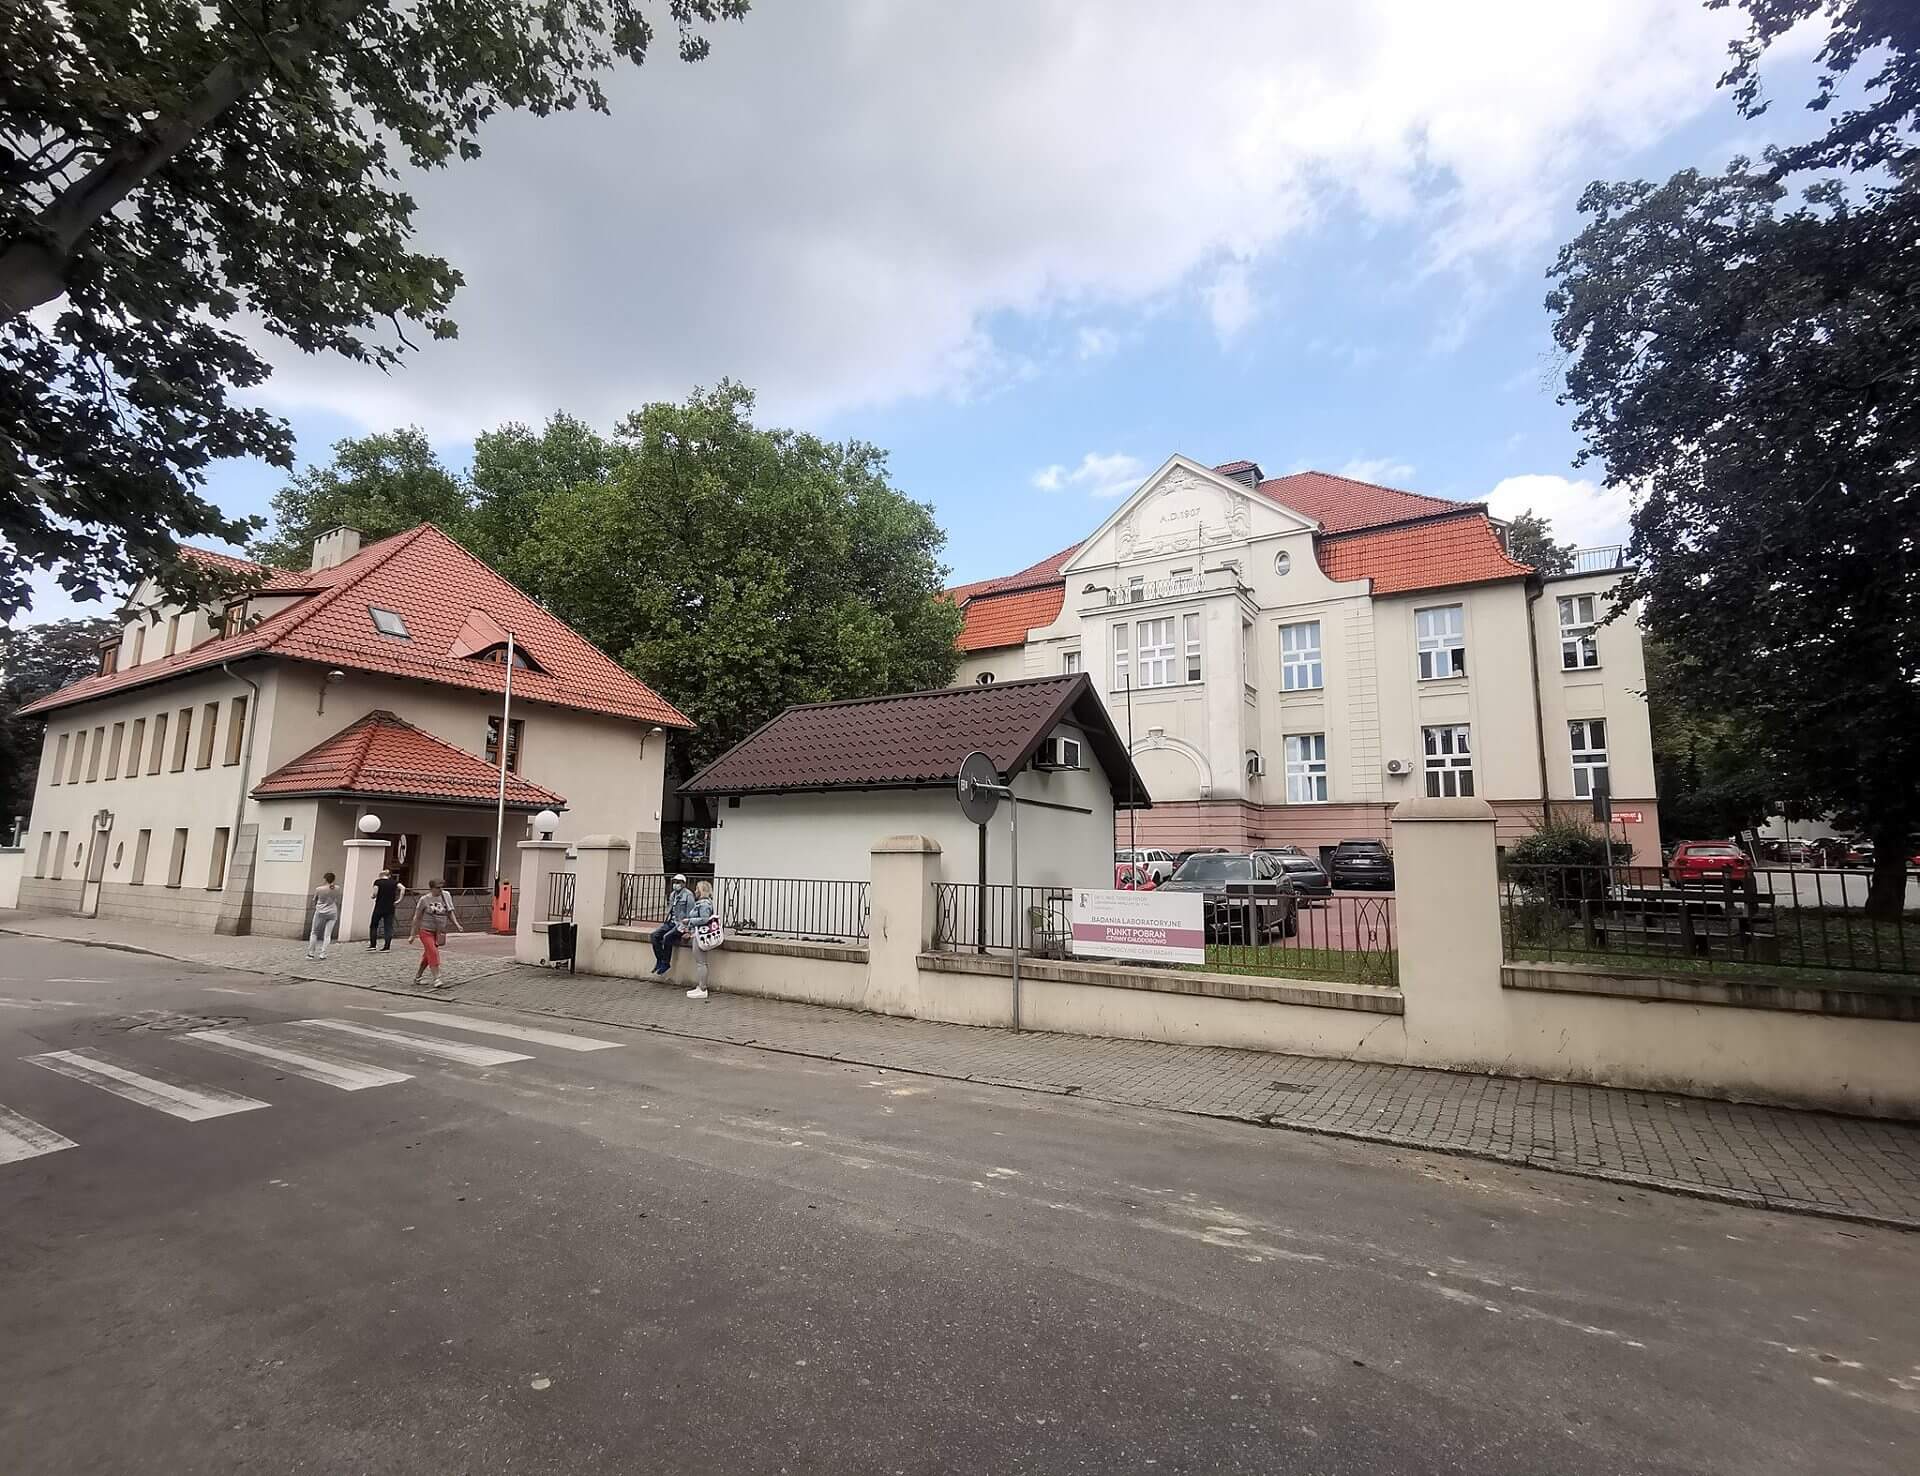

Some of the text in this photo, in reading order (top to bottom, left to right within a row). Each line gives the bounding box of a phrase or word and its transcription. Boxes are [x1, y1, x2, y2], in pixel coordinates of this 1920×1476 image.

[1091, 916, 1182, 928] BADANIA LABORATORYJNE
[1106, 927, 1166, 939] PUNKT POBRAŃ
